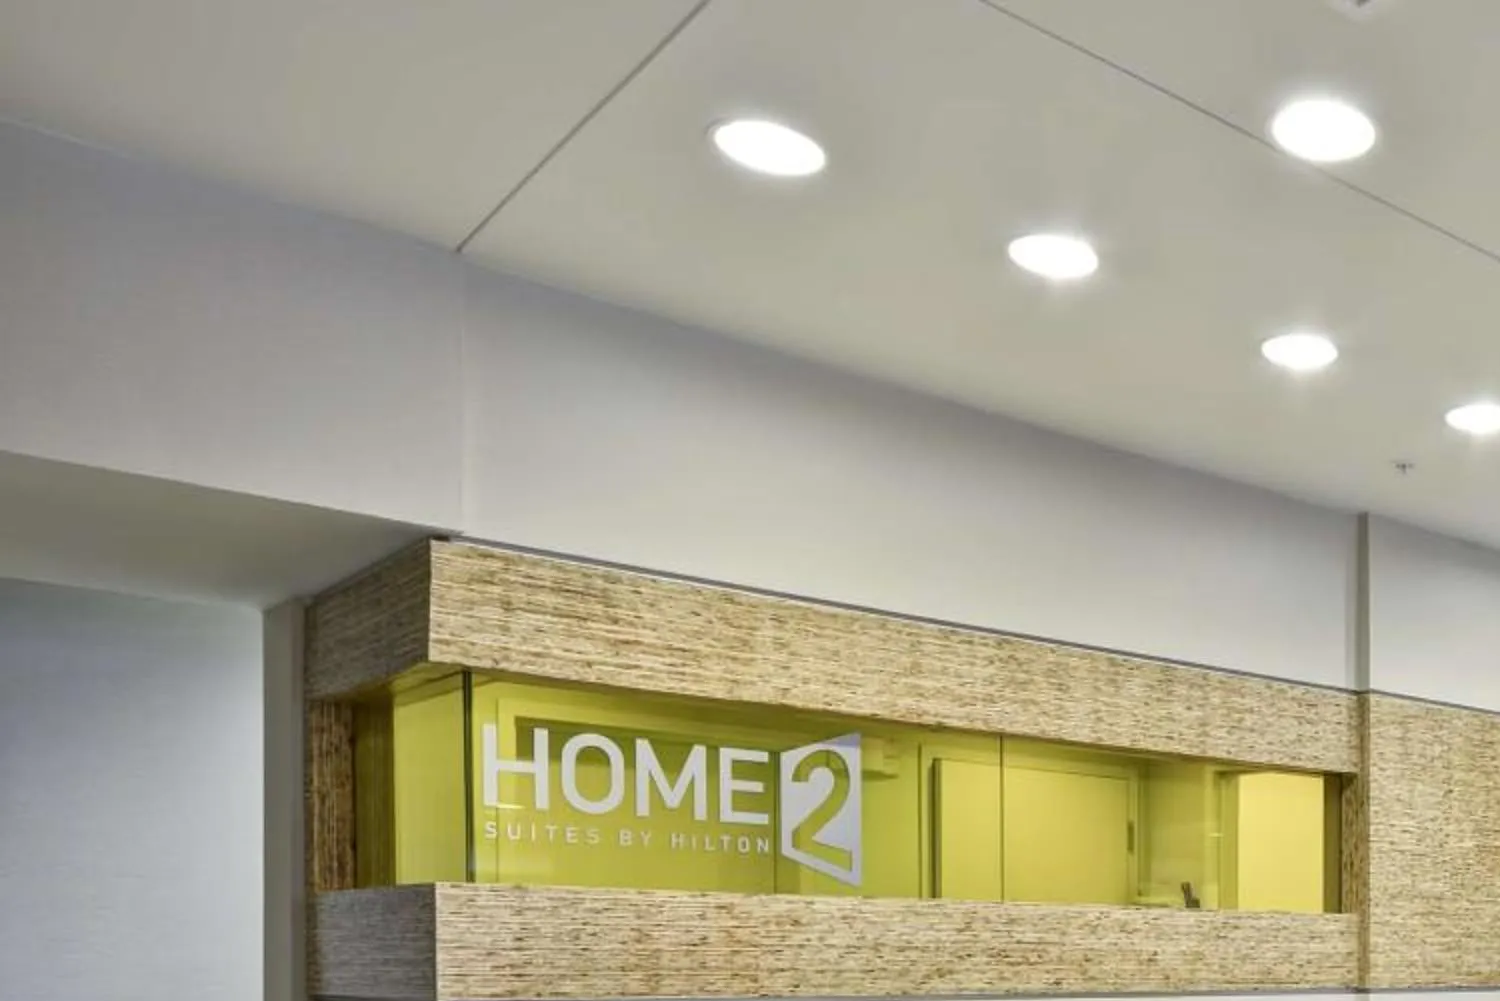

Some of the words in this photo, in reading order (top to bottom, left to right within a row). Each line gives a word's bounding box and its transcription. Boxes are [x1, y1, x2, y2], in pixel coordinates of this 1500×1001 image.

[484, 820, 600, 845] SUITES
[618, 828, 652, 847] BY
[671, 832, 769, 853] HILTON
